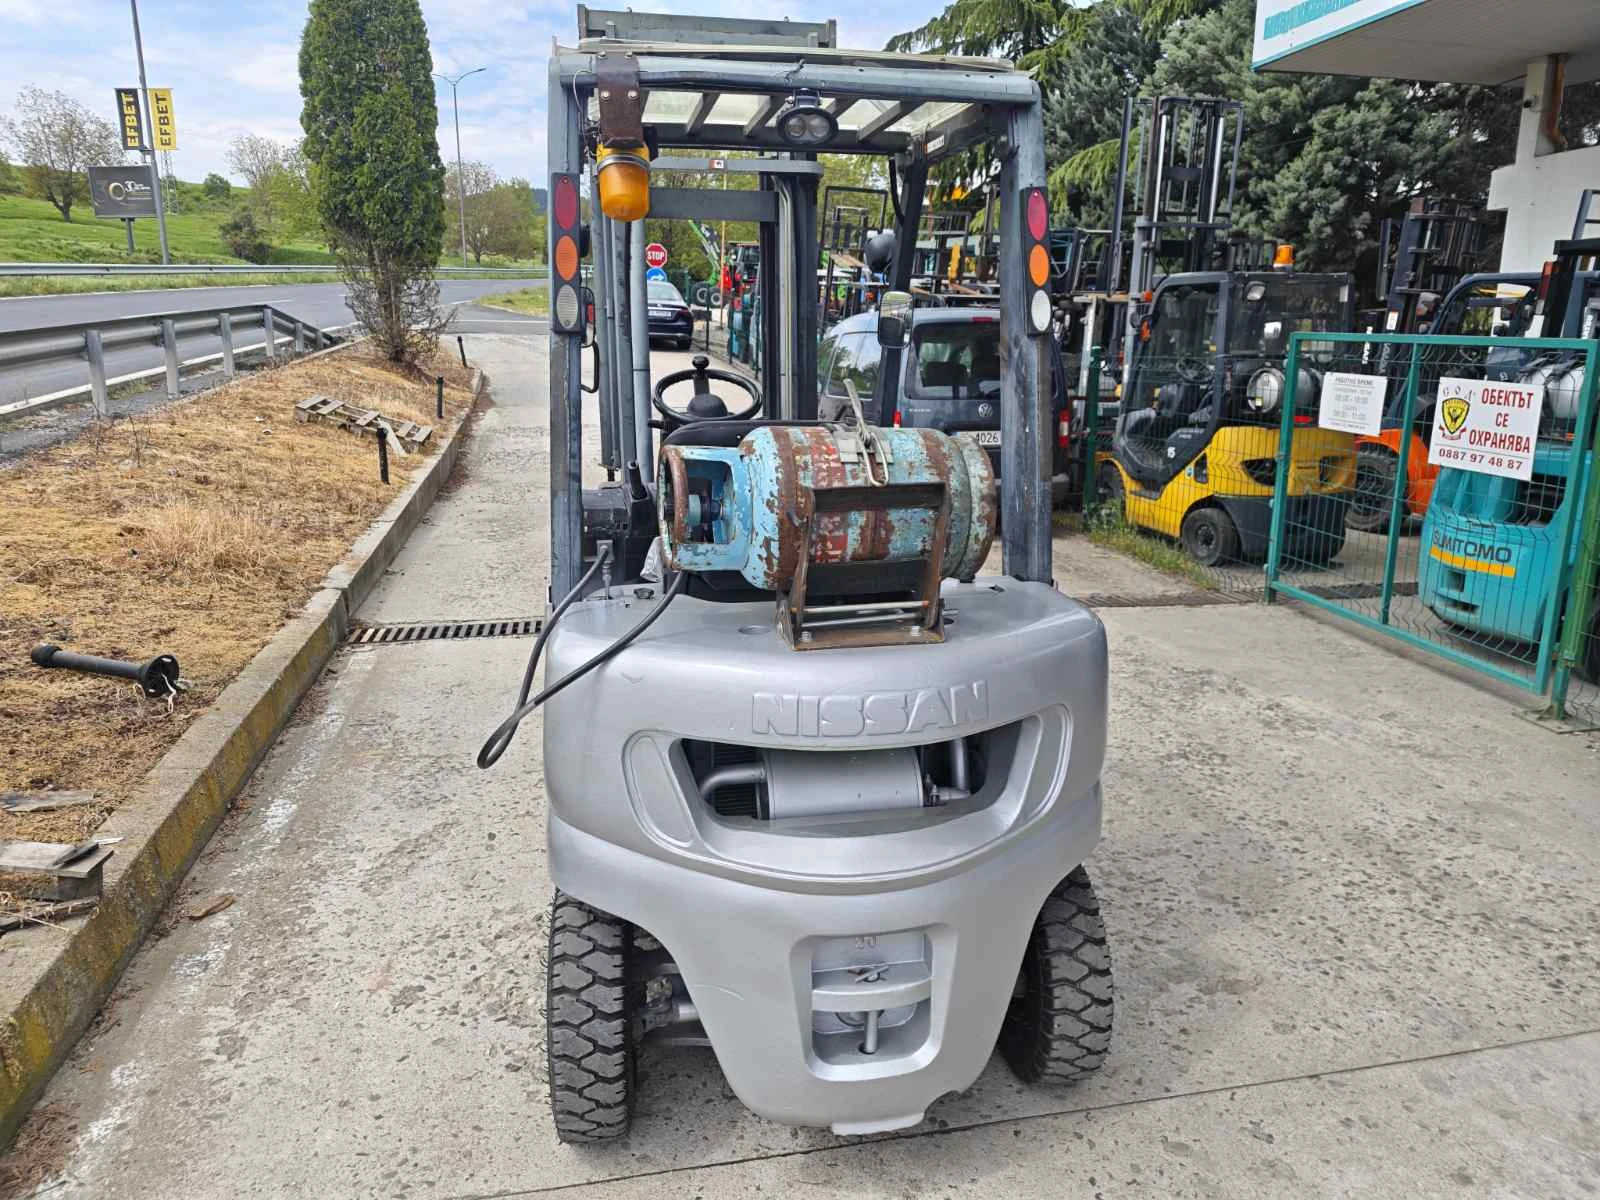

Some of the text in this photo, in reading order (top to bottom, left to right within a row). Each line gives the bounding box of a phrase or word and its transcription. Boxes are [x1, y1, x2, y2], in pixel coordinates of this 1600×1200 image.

[121, 92, 139, 147] EFBET
[155, 92, 171, 146] EFBET
[647, 251, 665, 260] STOP
[1482, 388, 1534, 409] ОБЕКТЪТ
[1496, 412, 1510, 428] СЕ
[1469, 429, 1530, 454] ОХРАНЯВА
[1439, 448, 1523, 471] 0887 97 48 87
[752, 681, 990, 737] NISSAN
